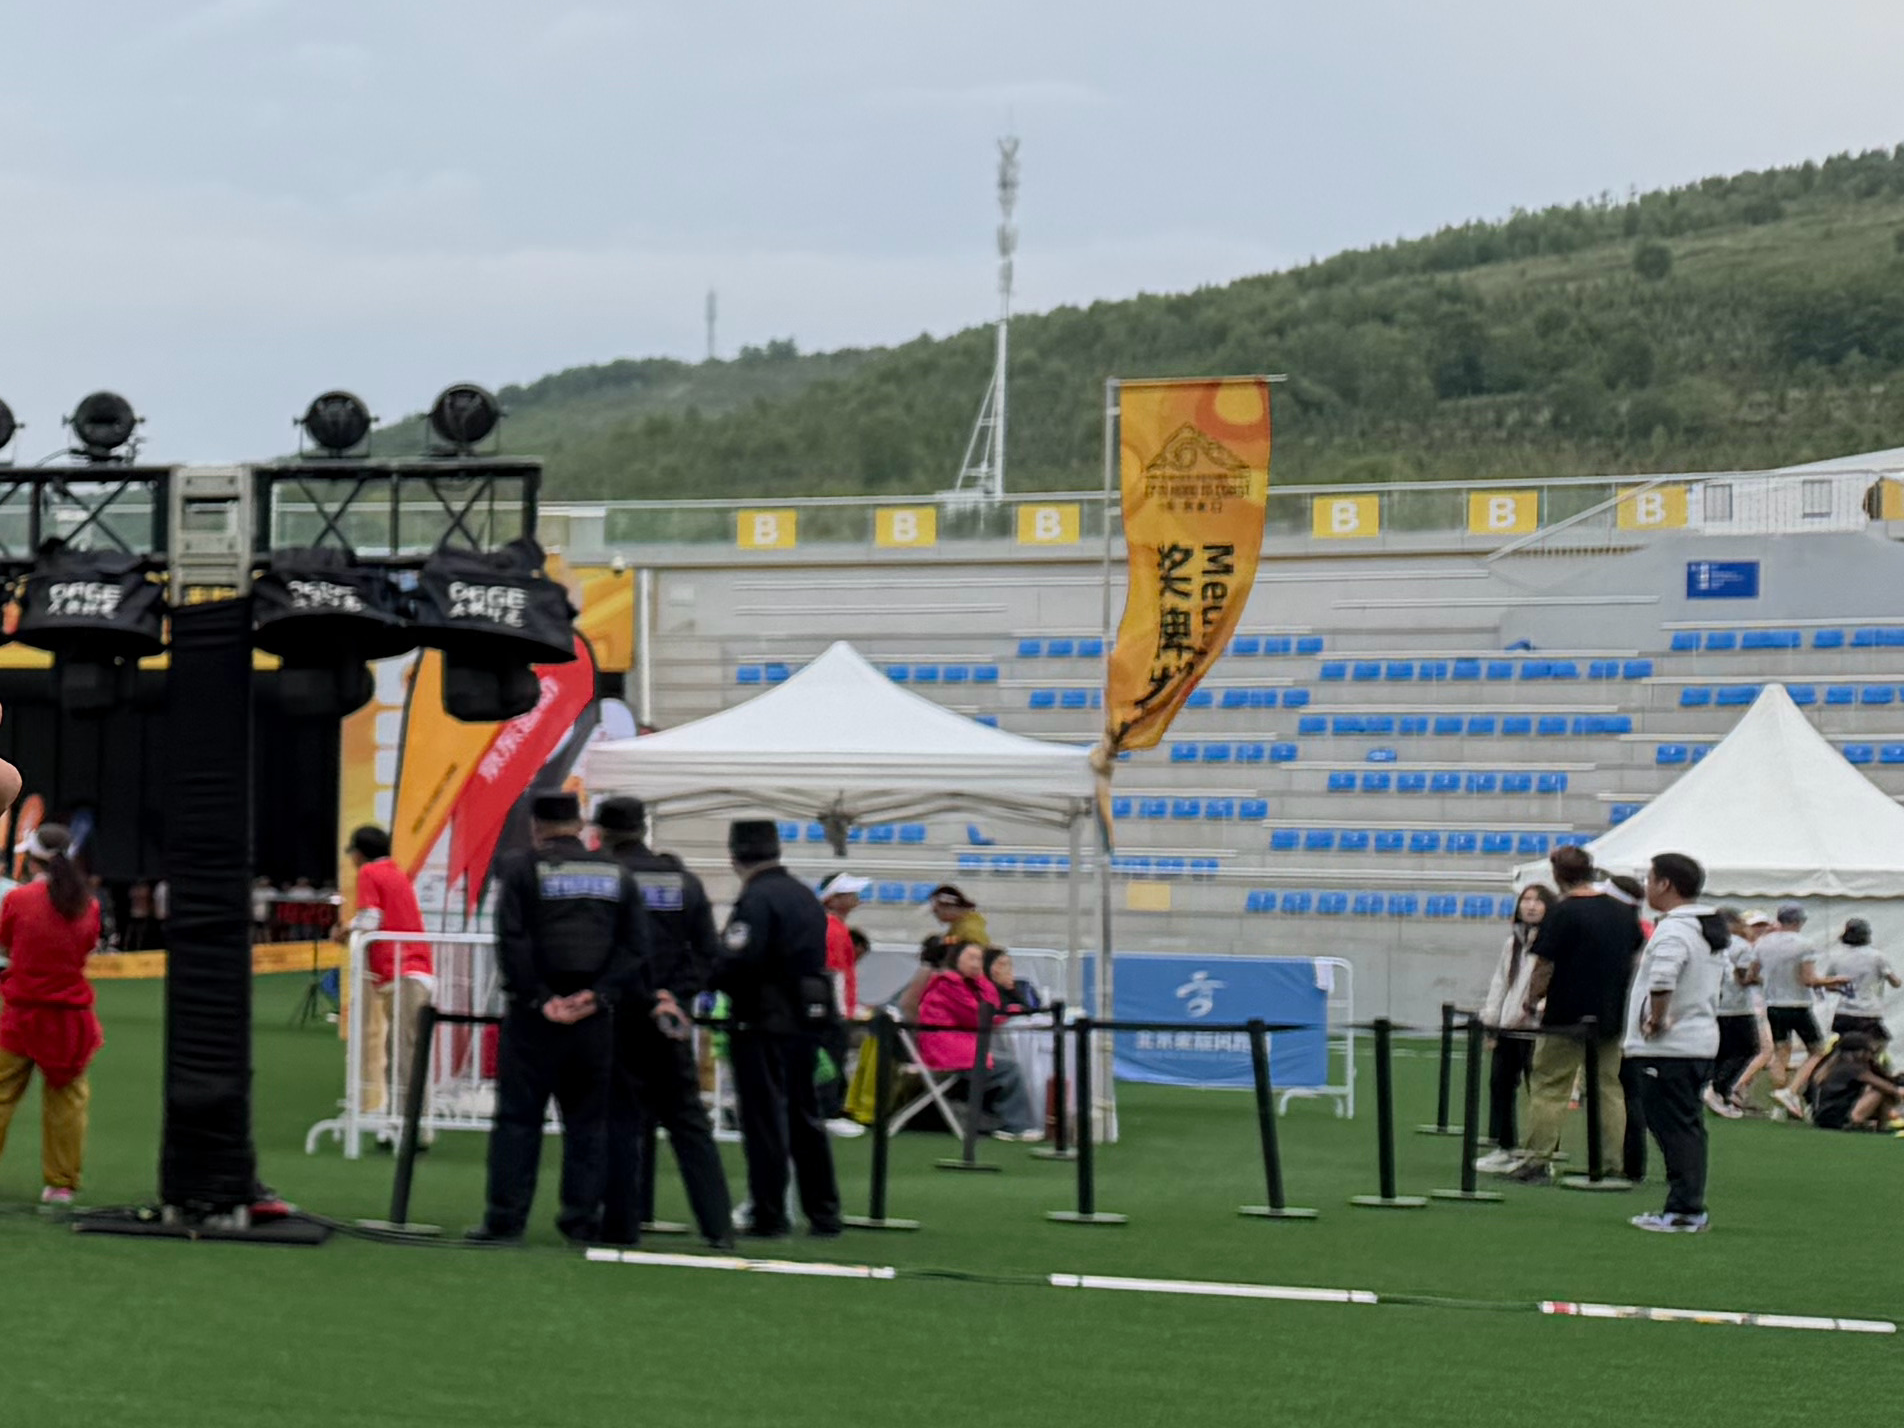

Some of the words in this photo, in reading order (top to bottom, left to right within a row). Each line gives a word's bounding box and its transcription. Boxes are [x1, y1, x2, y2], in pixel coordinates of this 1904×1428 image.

[1331, 501, 1358, 531] B
[1488, 498, 1516, 528] B
[1636, 492, 1665, 523] B
[754, 515, 777, 544] B
[893, 512, 918, 541] B
[1035, 509, 1060, 538] B
